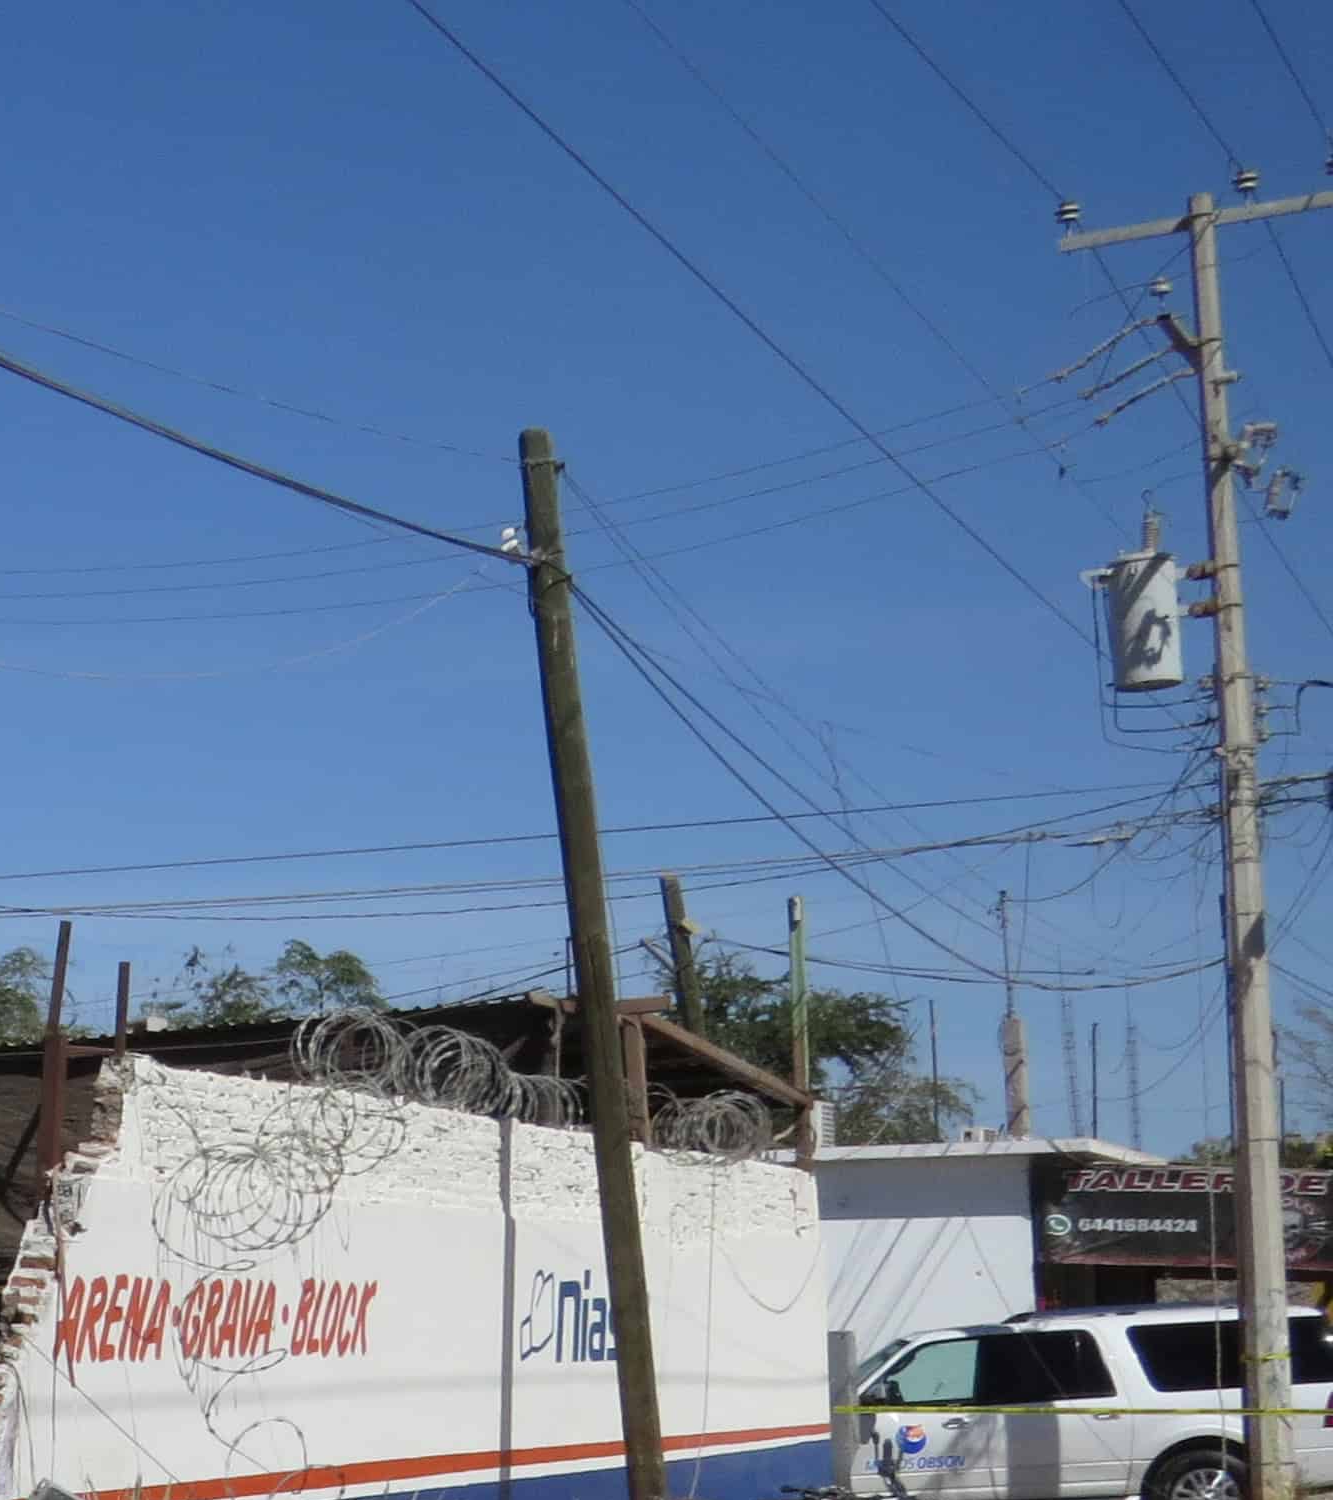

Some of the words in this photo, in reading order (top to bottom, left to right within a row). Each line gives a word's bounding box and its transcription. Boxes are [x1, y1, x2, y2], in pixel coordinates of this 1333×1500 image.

[1067, 1169, 1235, 1192] TALLER
[54, 1275, 172, 1363] ARENA
[182, 1278, 276, 1359] GRAVA
[291, 1277, 378, 1357] BLOCK
